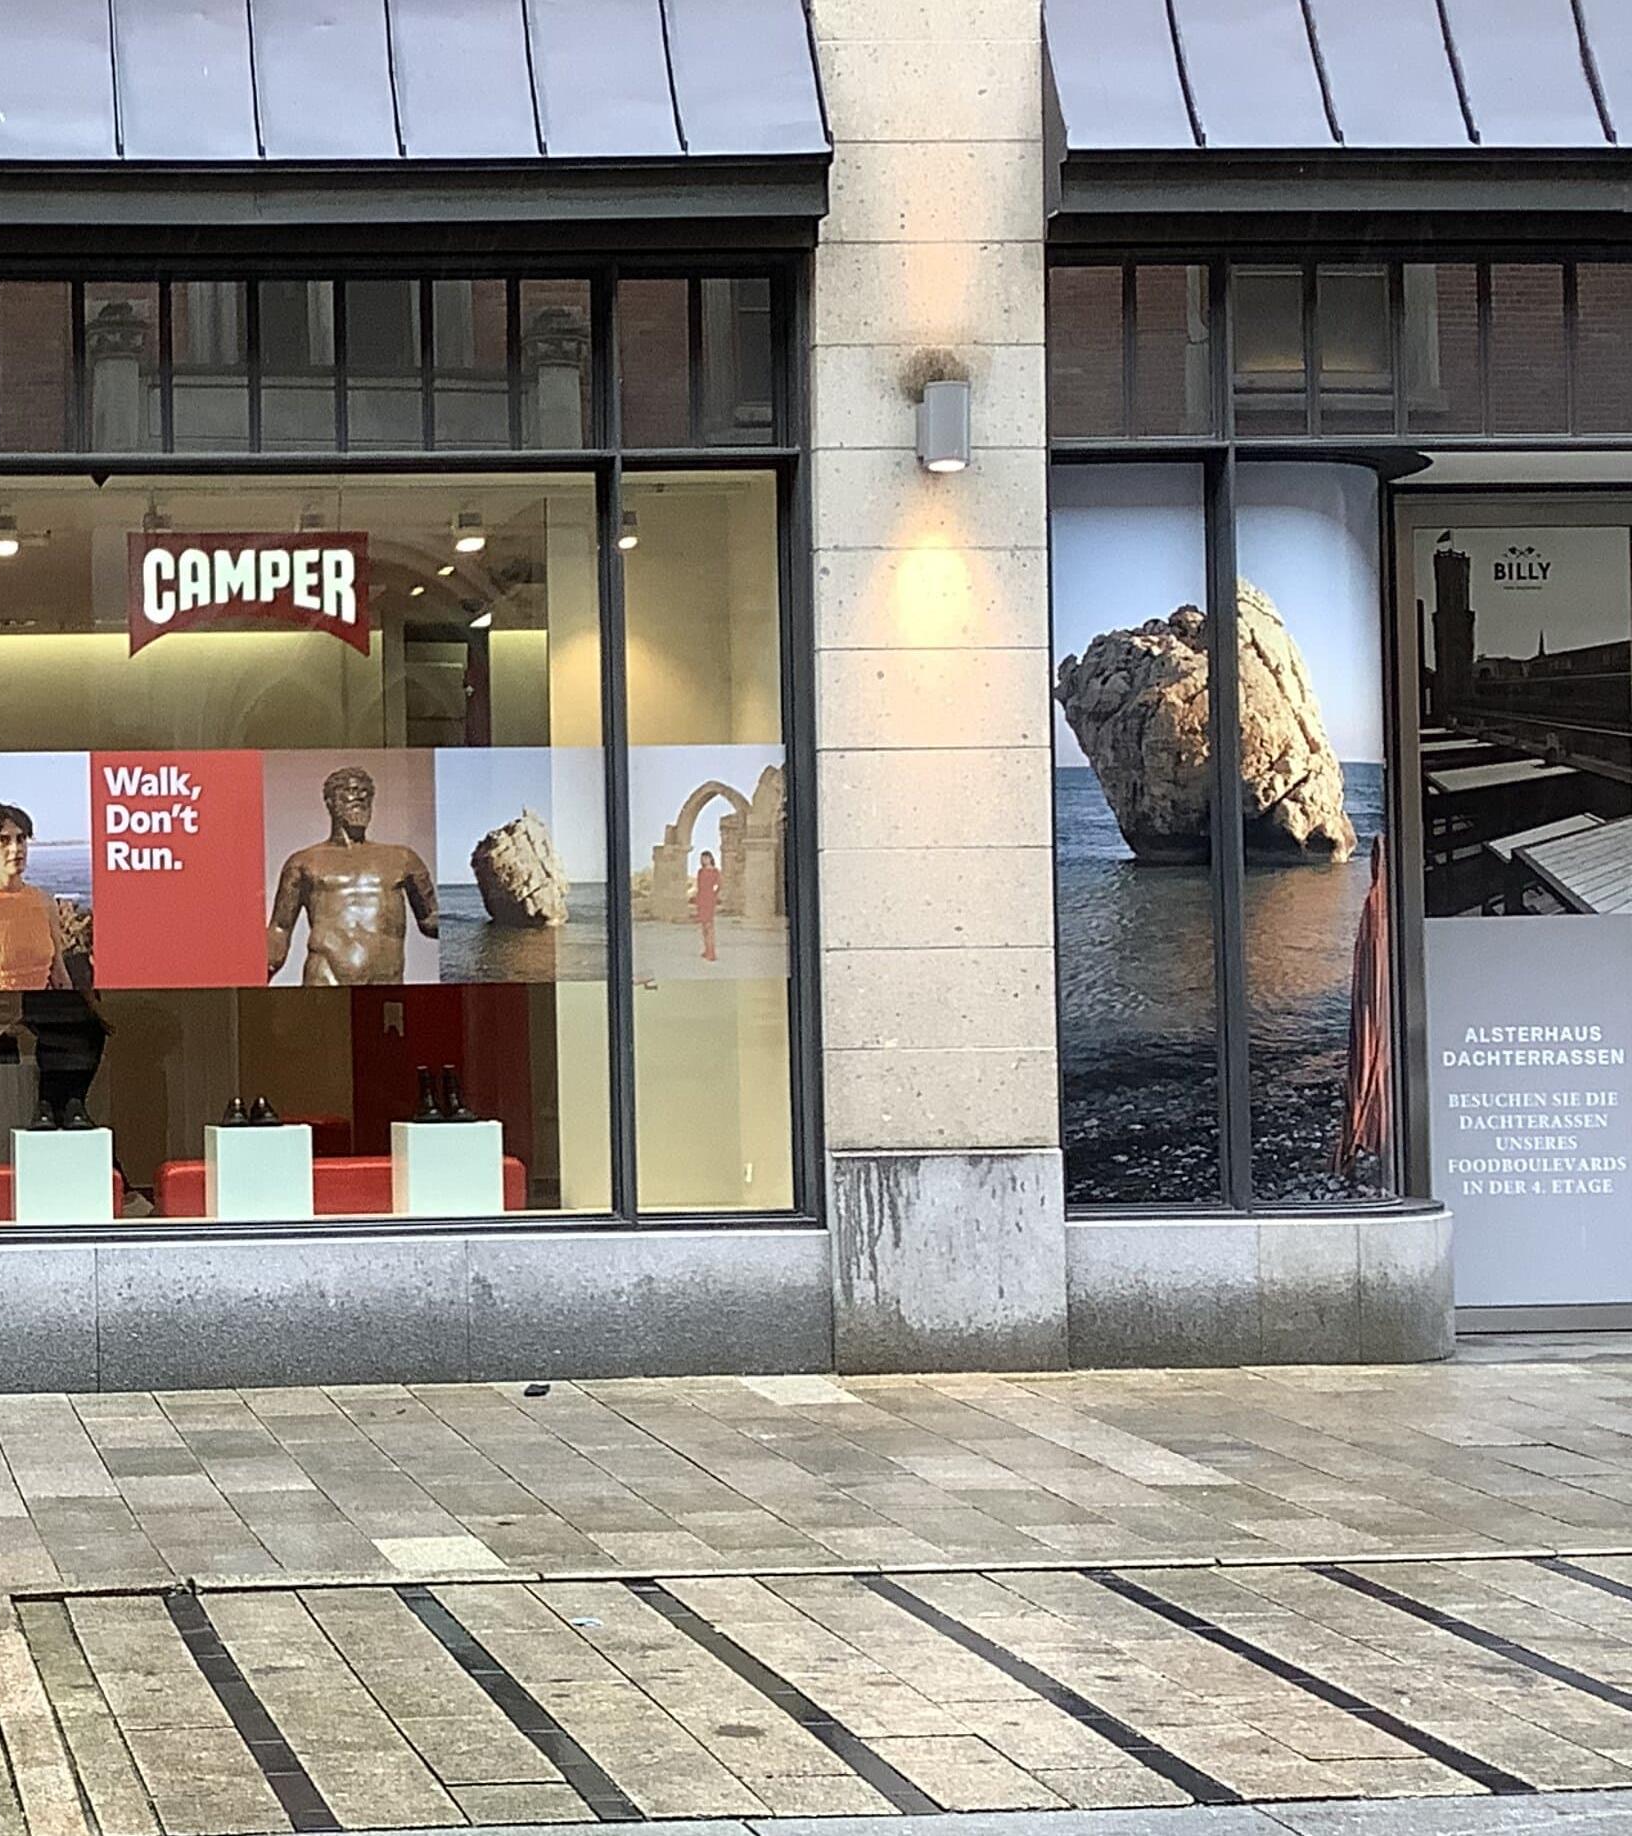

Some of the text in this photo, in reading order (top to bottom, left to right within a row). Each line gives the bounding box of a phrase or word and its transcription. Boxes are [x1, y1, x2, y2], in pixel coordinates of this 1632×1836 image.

[1494, 562, 1551, 580] BILLY
[143, 548, 356, 625] CAMPER
[103, 766, 202, 801] Walk,
[106, 803, 199, 834] Don't
[106, 841, 183, 871] Run.
[1465, 1025, 1602, 1043] ALSTERHAUS
[1442, 1048, 1625, 1066] DACHTERRASSEN
[1448, 1091, 1618, 1108] BESUCHEN SIE DIE
[1459, 1113, 1608, 1130] DACHTERASSEN
[1495, 1136, 1578, 1151] UNSERES
[1448, 1156, 1627, 1174] FOODBOULEVARDS
[1462, 1178, 1614, 1195] IN DER 4. ETAGE
